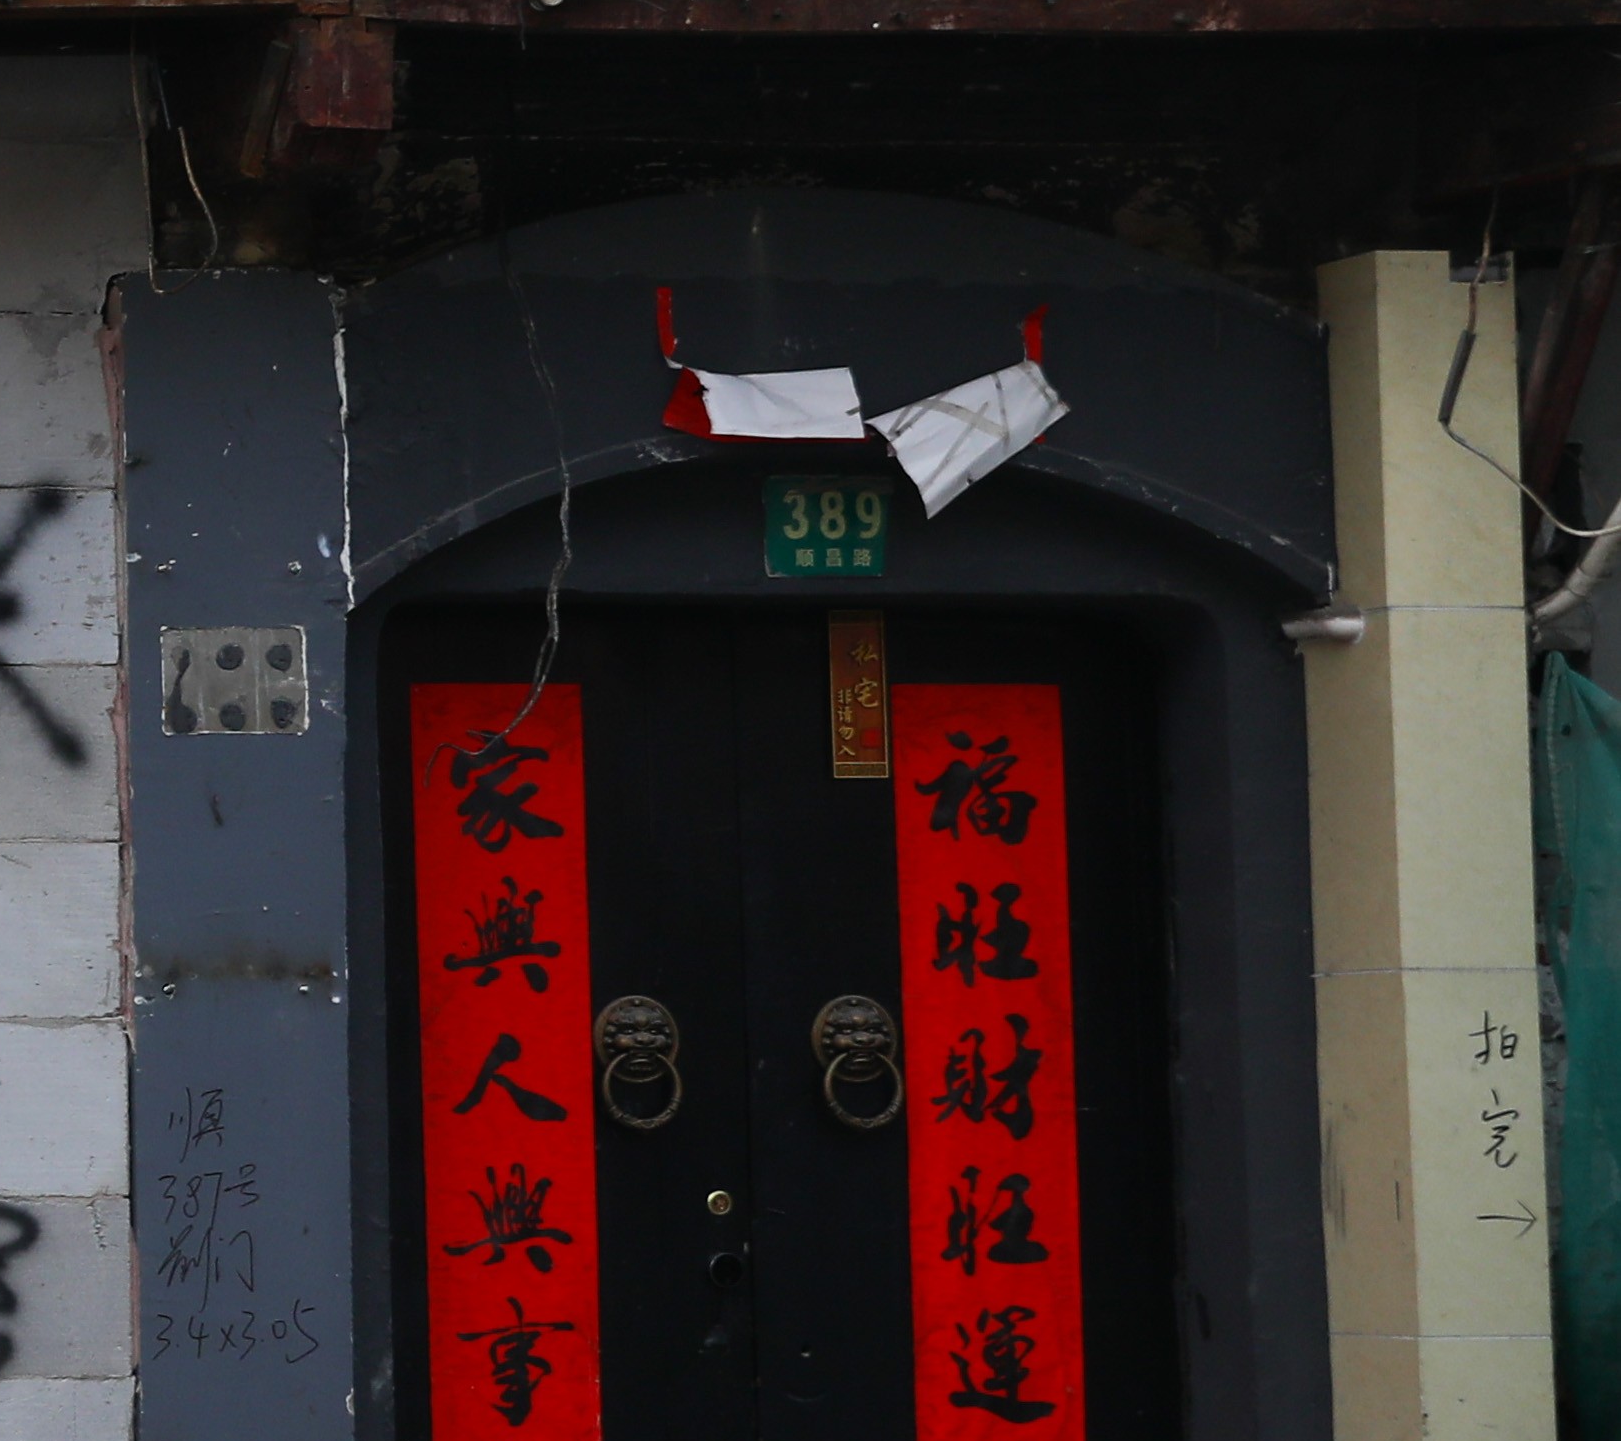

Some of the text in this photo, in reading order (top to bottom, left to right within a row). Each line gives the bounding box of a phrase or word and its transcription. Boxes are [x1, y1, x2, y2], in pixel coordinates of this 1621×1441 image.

[783, 490, 882, 540] 389
[795, 548, 872, 567] 顺昌路
[850, 640, 879, 708] 私宅
[837, 688, 856, 756] 非请勿入
